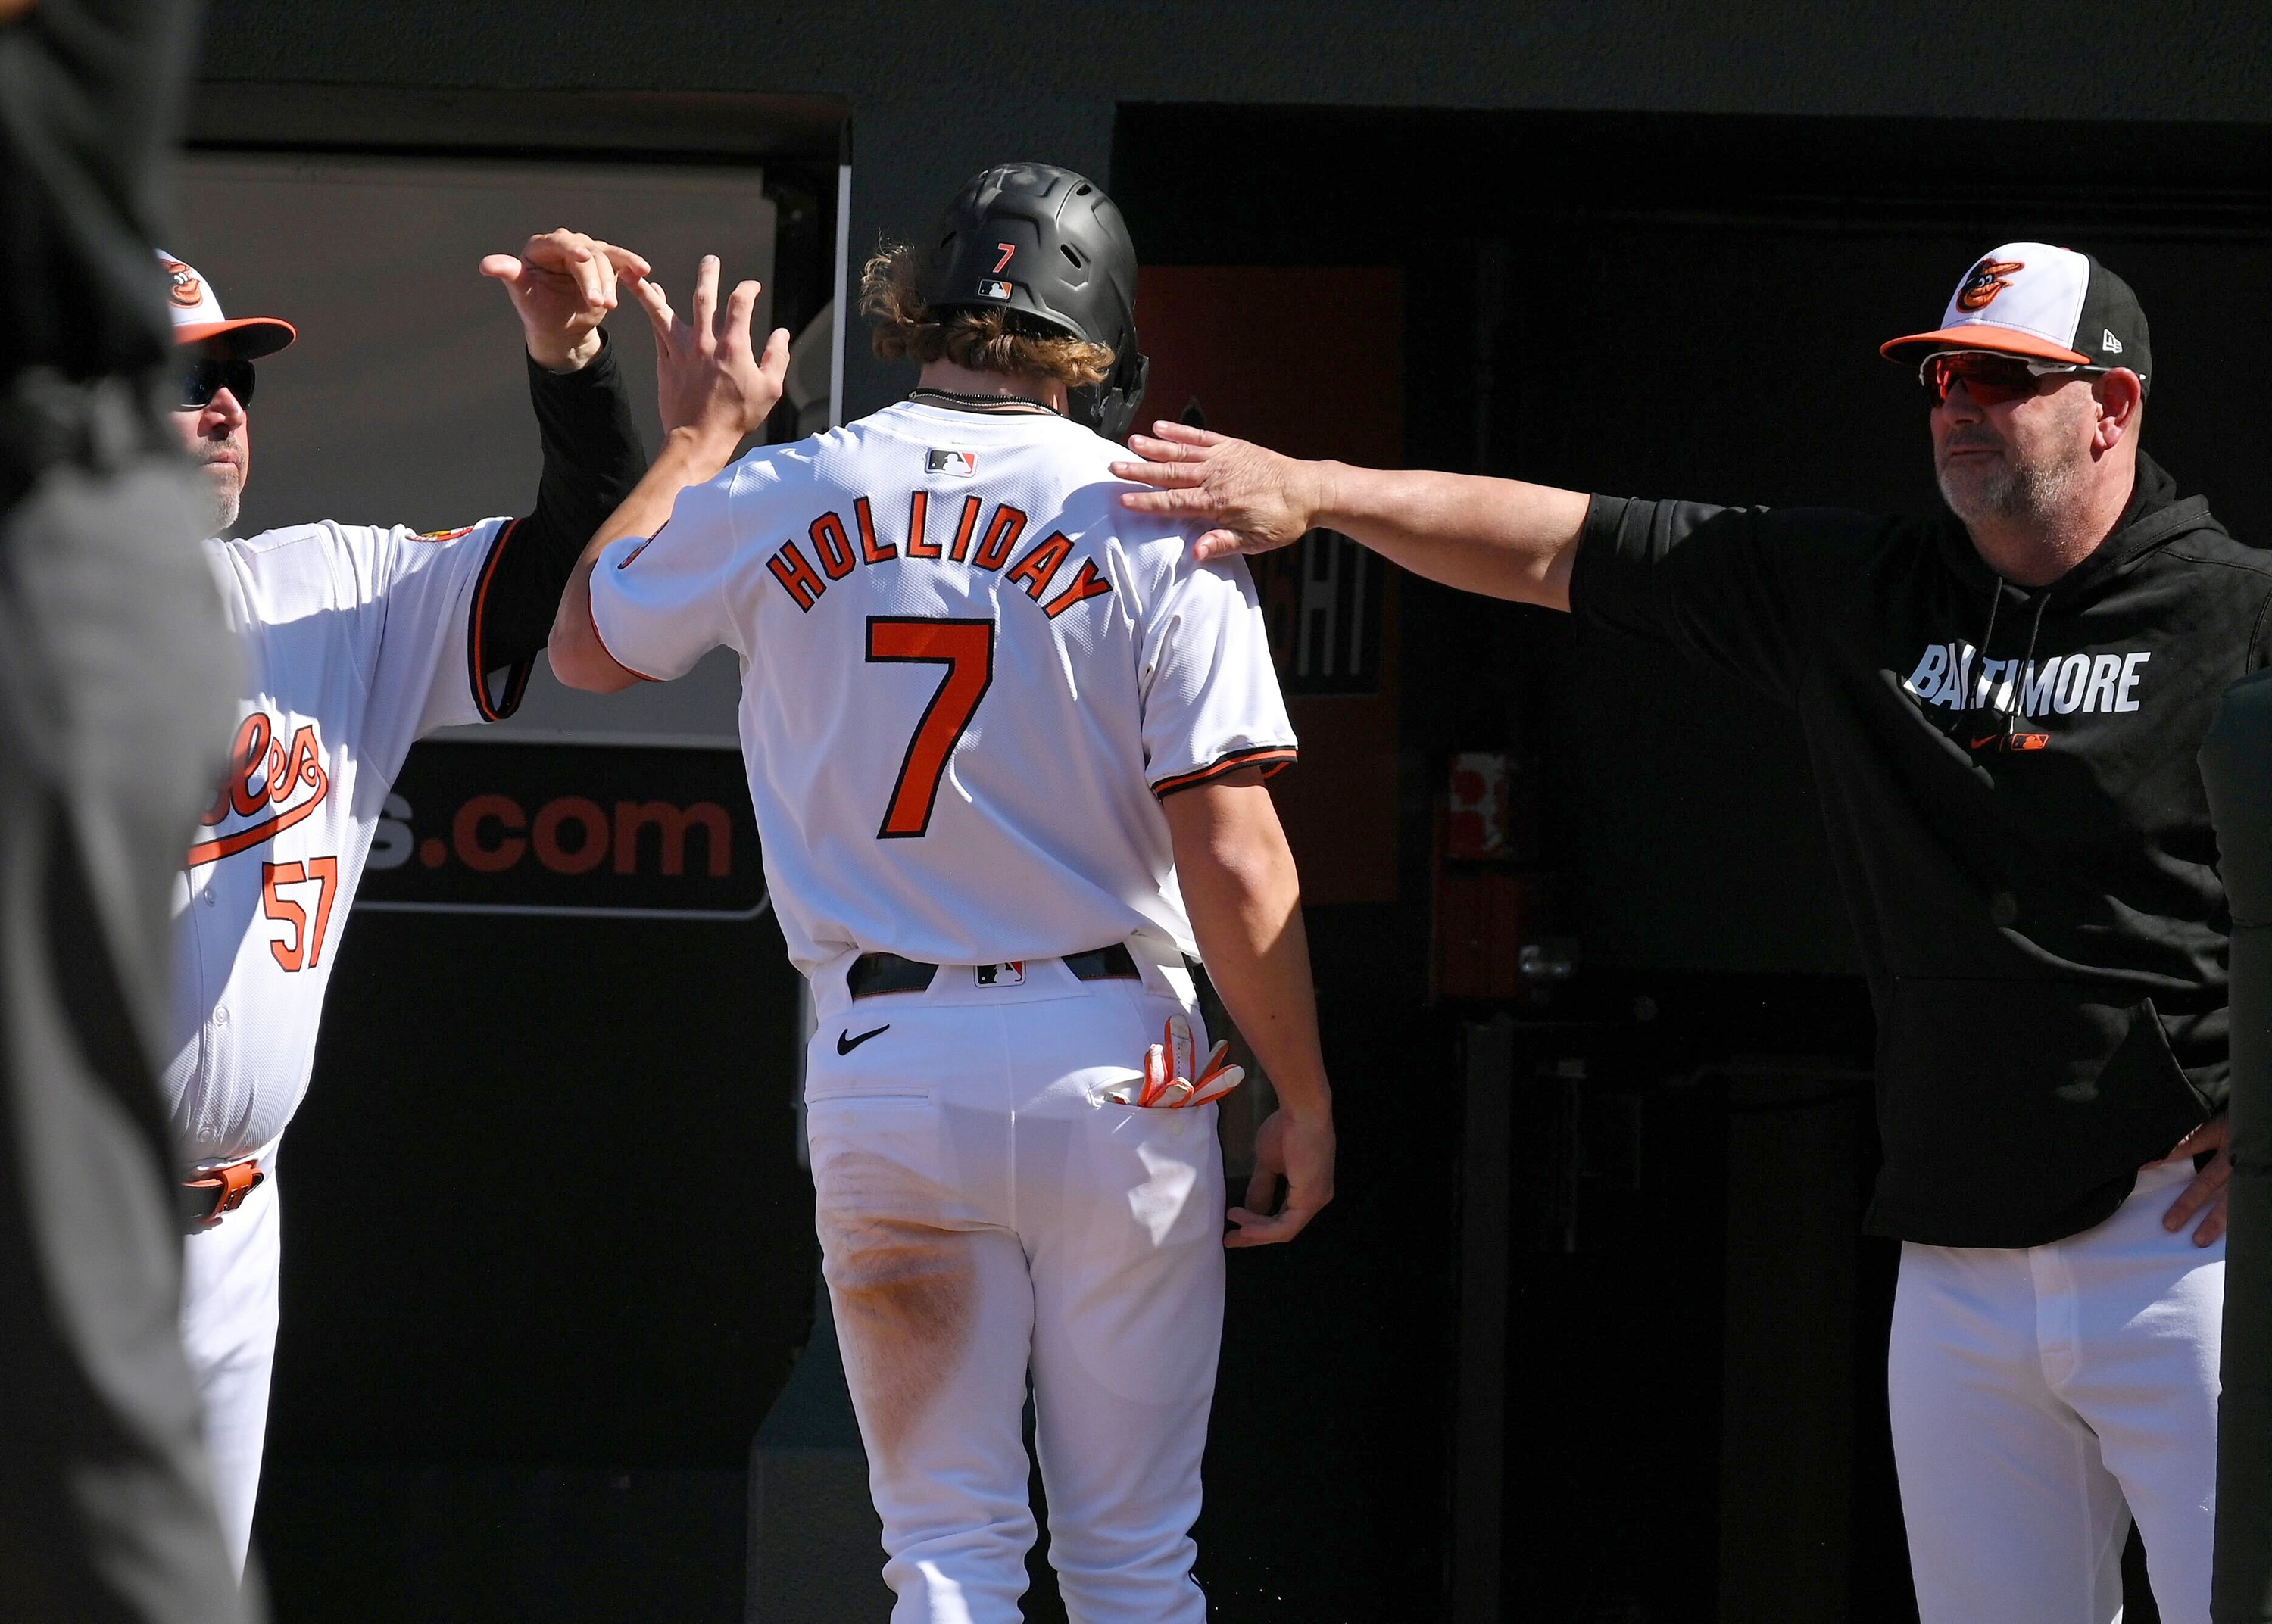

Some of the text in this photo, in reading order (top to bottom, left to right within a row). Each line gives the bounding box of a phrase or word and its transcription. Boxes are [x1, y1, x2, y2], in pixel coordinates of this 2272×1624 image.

[993, 243, 1016, 273] 7
[766, 491, 1113, 621] HOLLIDAY
[865, 616, 996, 840] 7
[1902, 642, 2152, 718] BALTIMORE
[261, 856, 338, 973] 57
